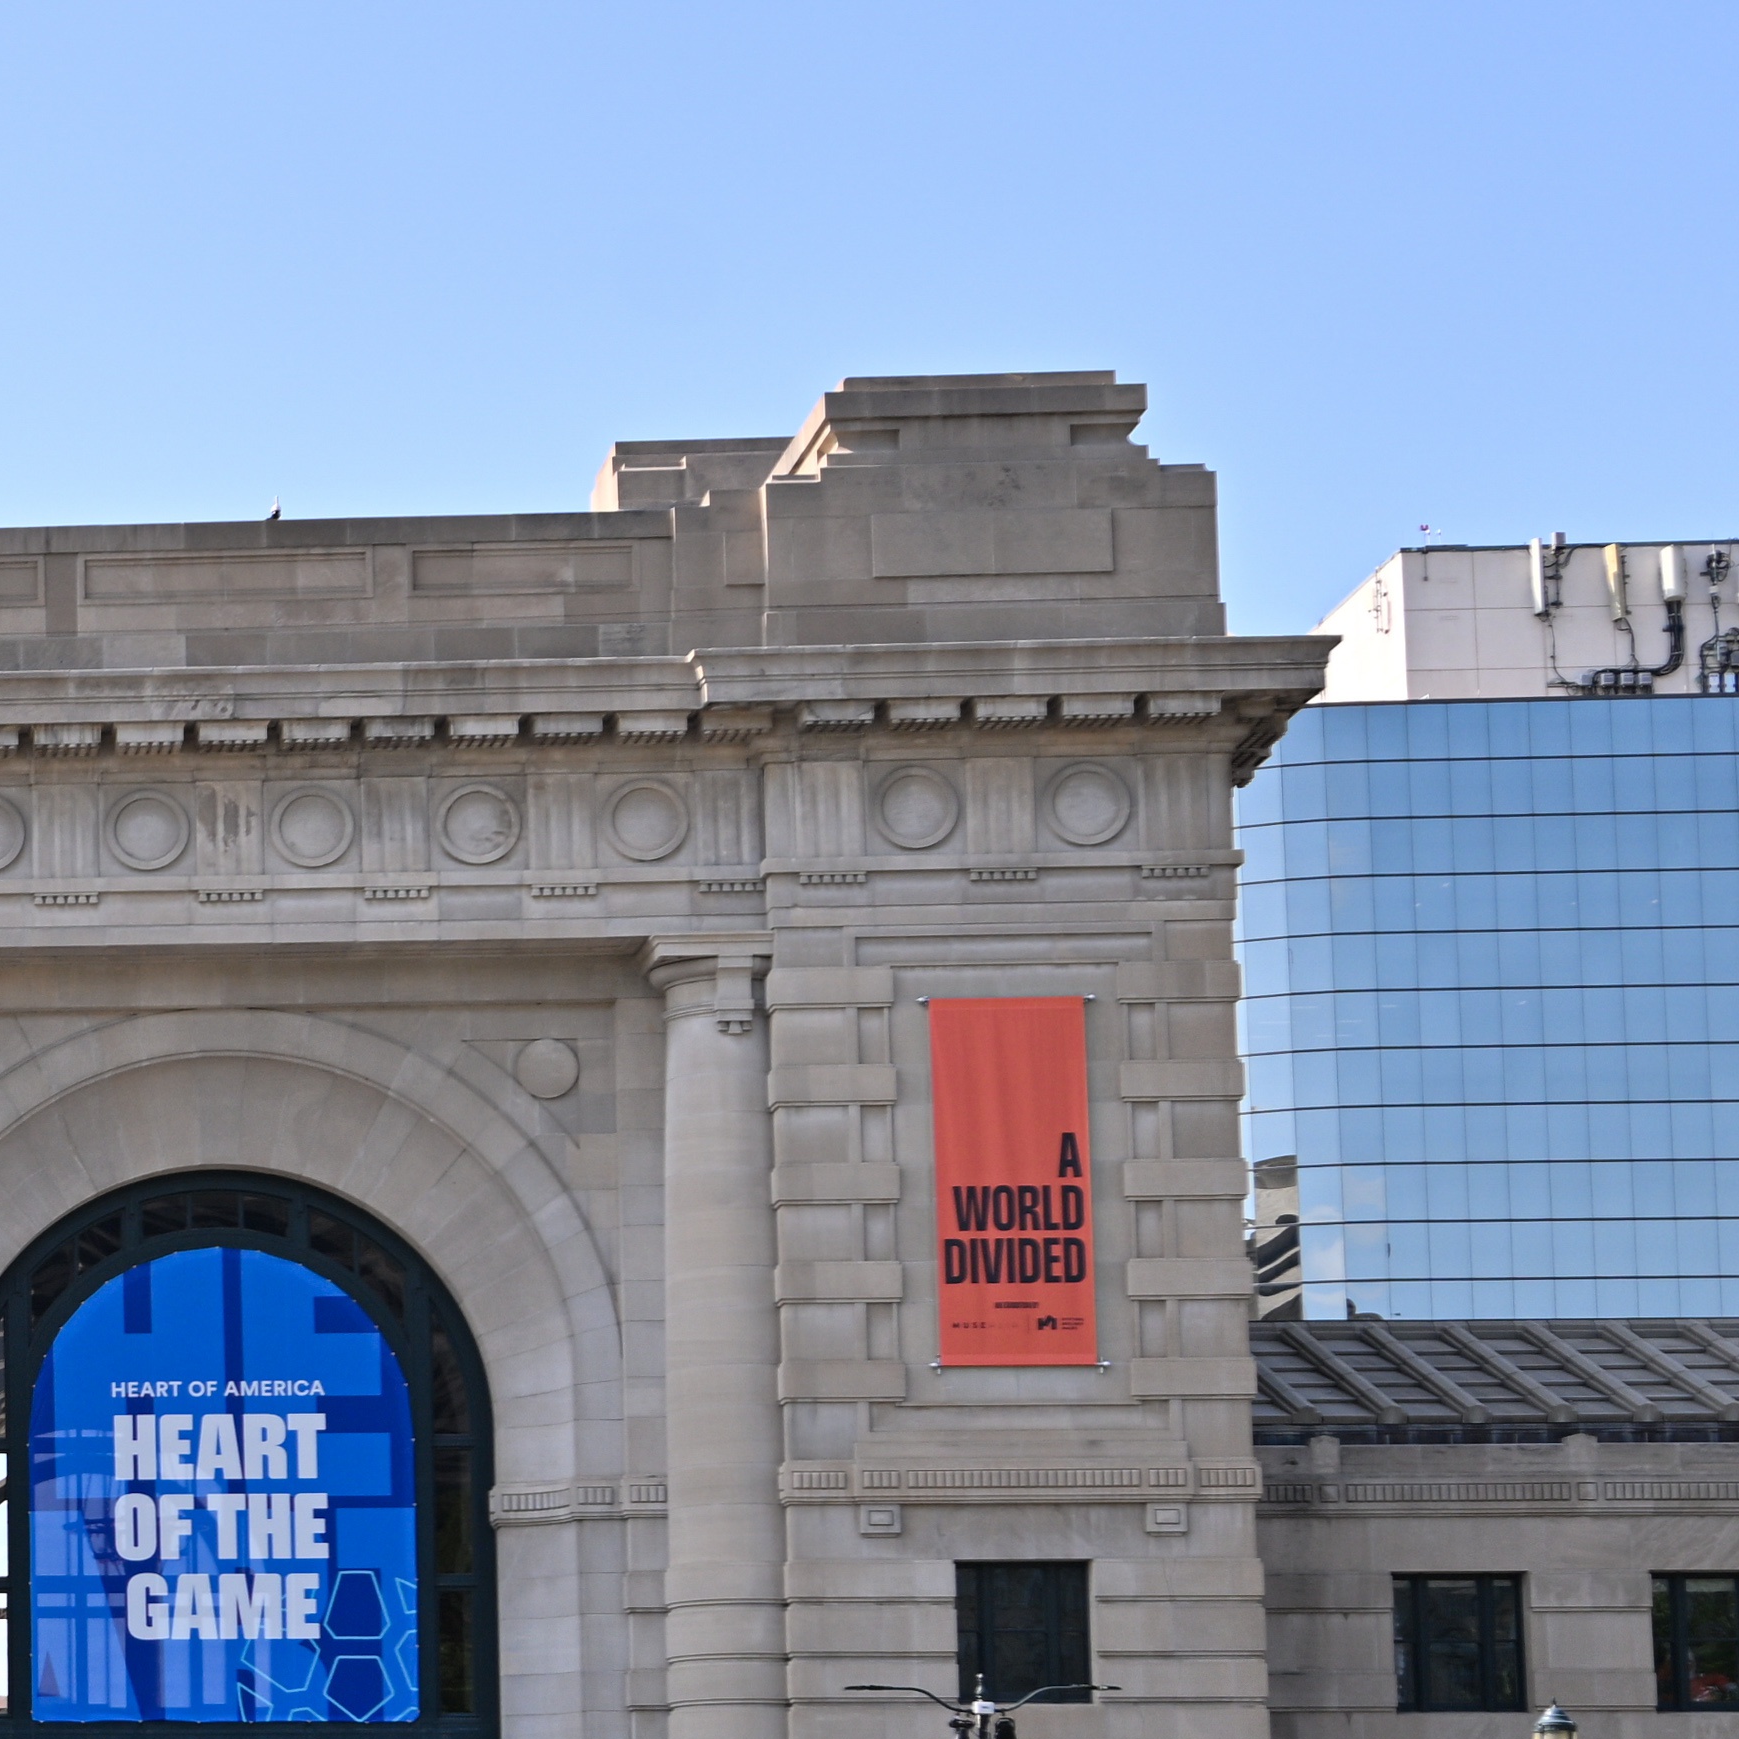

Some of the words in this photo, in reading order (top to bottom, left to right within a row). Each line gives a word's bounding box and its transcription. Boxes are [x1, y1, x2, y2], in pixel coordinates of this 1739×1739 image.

[1058, 1132, 1083, 1178] A
[952, 1185, 1085, 1231] WORLD
[944, 1237, 1087, 1284] DIVIDED
[111, 1381, 182, 1398] HEART
[188, 1381, 218, 1397] OF
[224, 1379, 326, 1397] AMERICA
[113, 1413, 326, 1480] HEART
[113, 1492, 195, 1561] OF
[207, 1492, 329, 1560] THE
[126, 1572, 321, 1641] GAME
